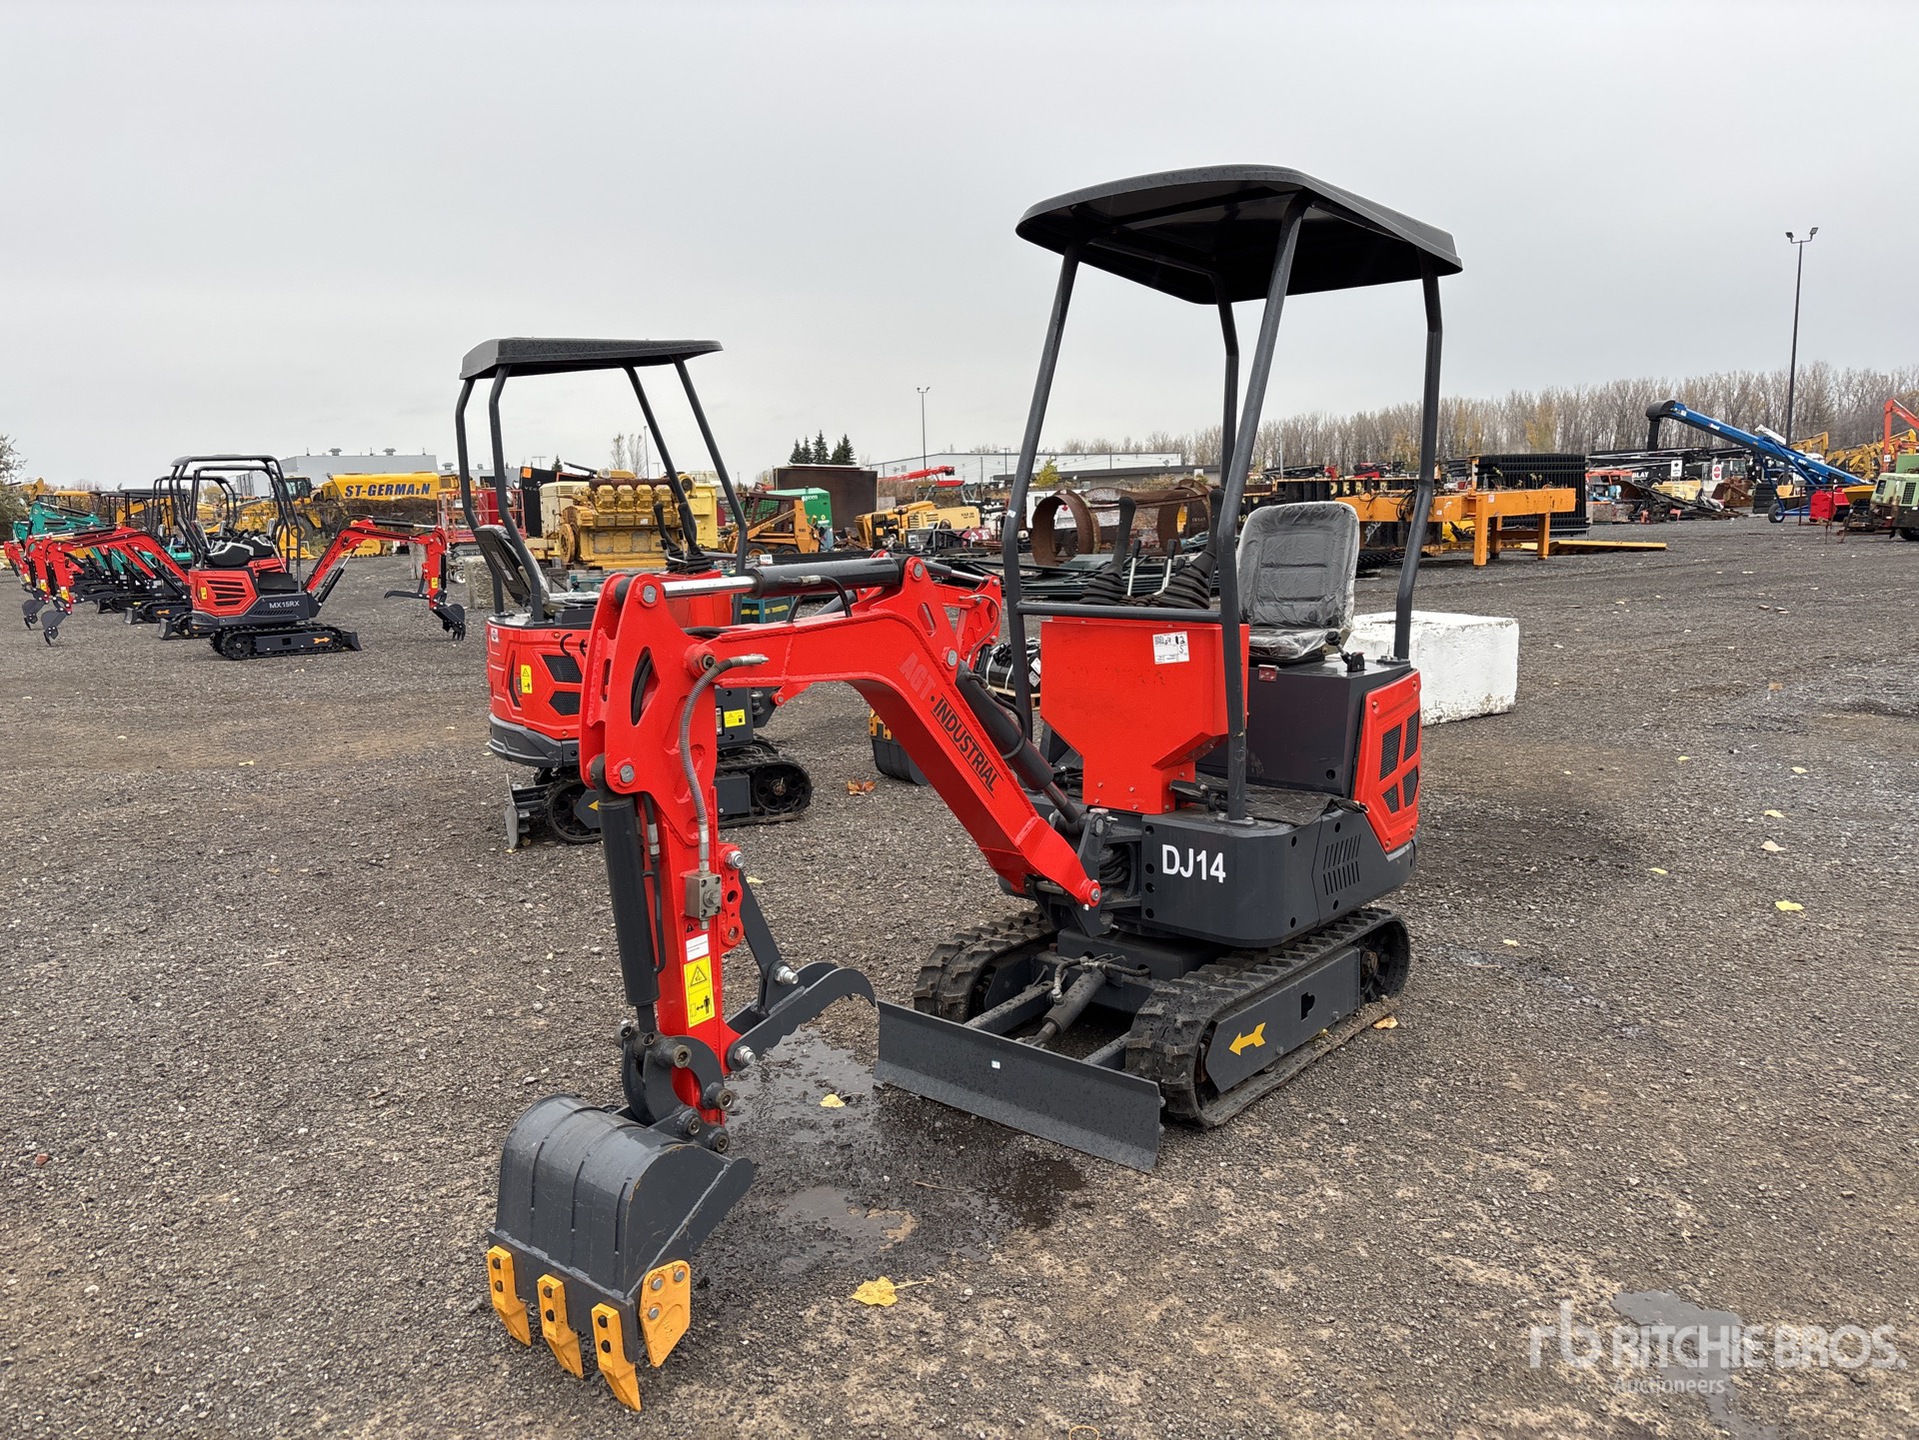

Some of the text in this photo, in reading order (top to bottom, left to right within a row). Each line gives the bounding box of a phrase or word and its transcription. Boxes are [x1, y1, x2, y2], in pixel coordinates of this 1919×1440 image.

[269, 601, 300, 609] MX15RX
[932, 697, 999, 792] INDUSTRIAL
[1162, 844, 1226, 883] DJ14
